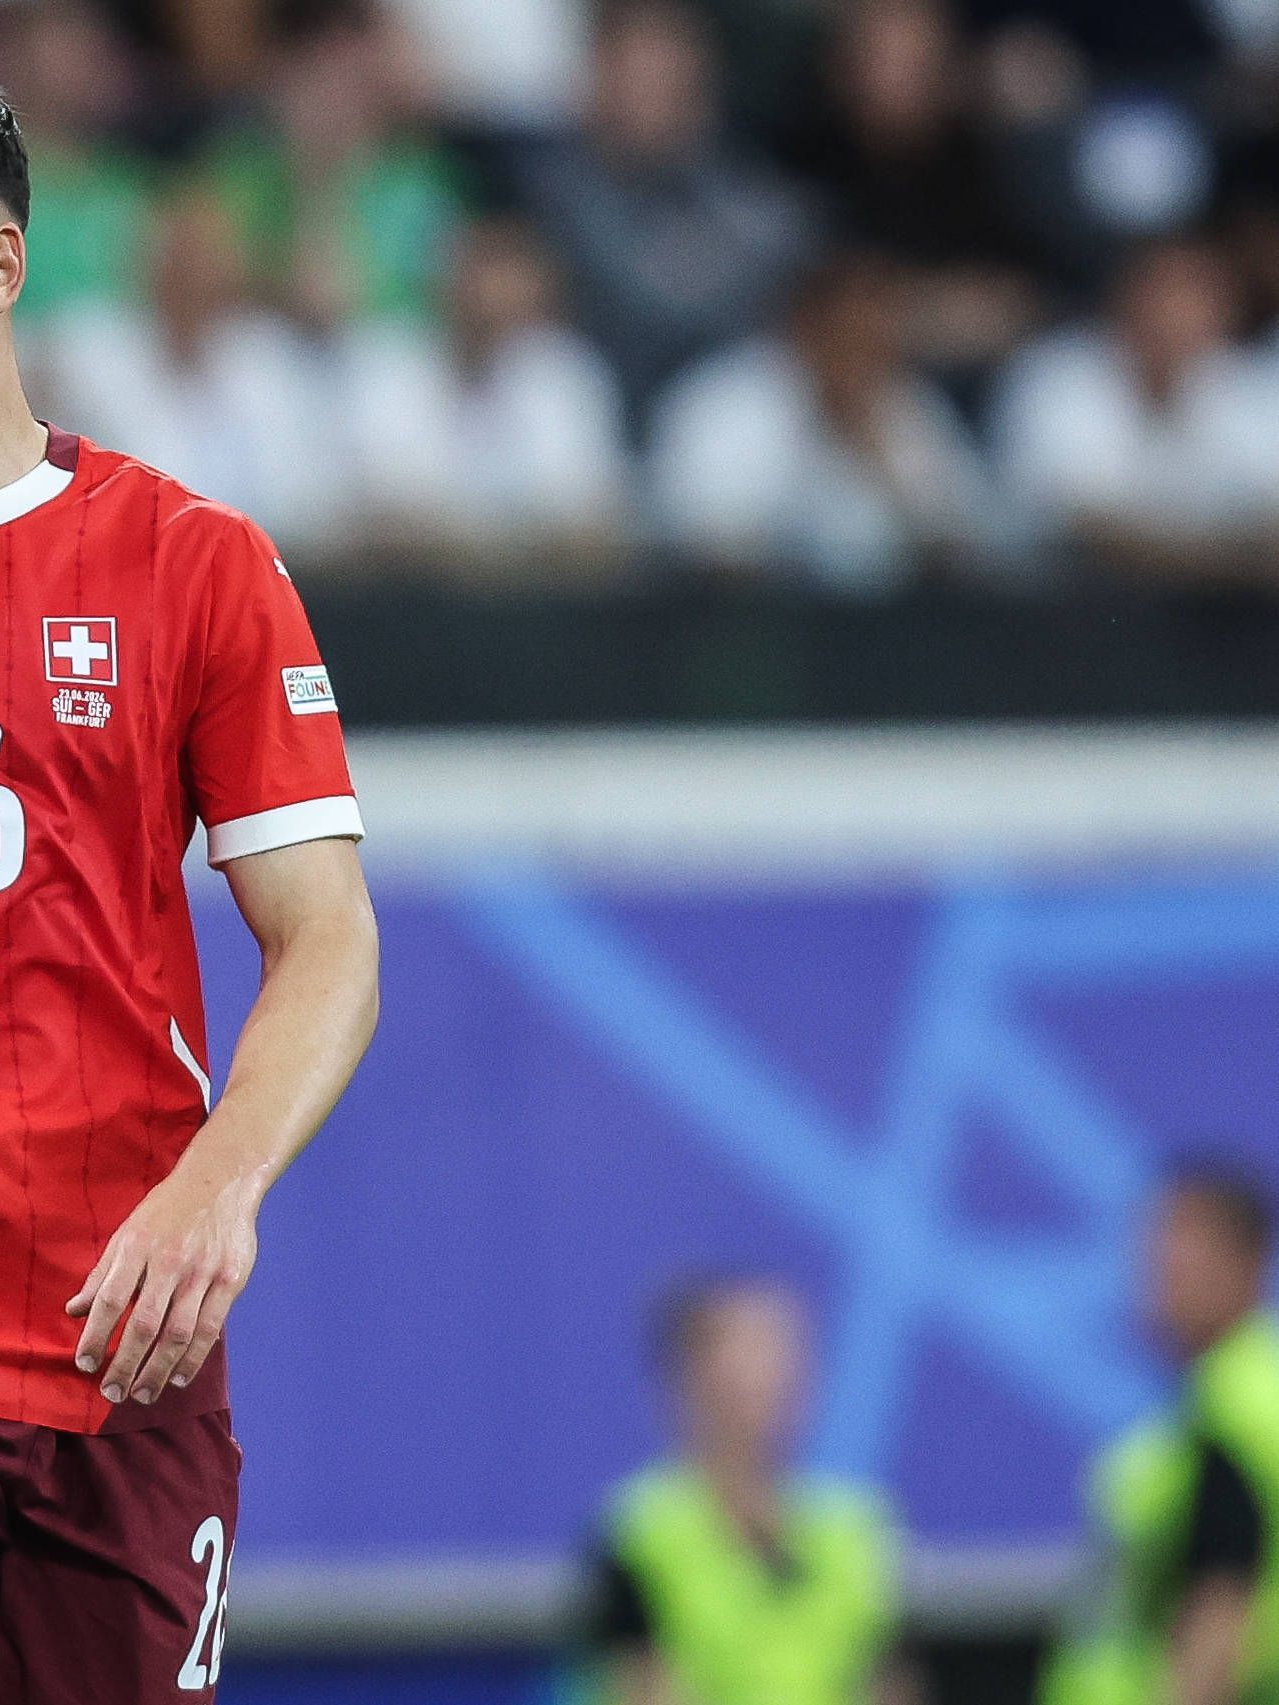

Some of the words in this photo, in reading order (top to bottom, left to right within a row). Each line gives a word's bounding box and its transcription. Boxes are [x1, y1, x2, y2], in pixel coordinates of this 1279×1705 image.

[286, 671, 304, 681] UEFA
[58, 688, 106, 703] 23.06.2024
[52, 697, 73, 713] SUI
[87, 701, 112, 718] GER
[56, 712, 106, 729] FRANKFURT
